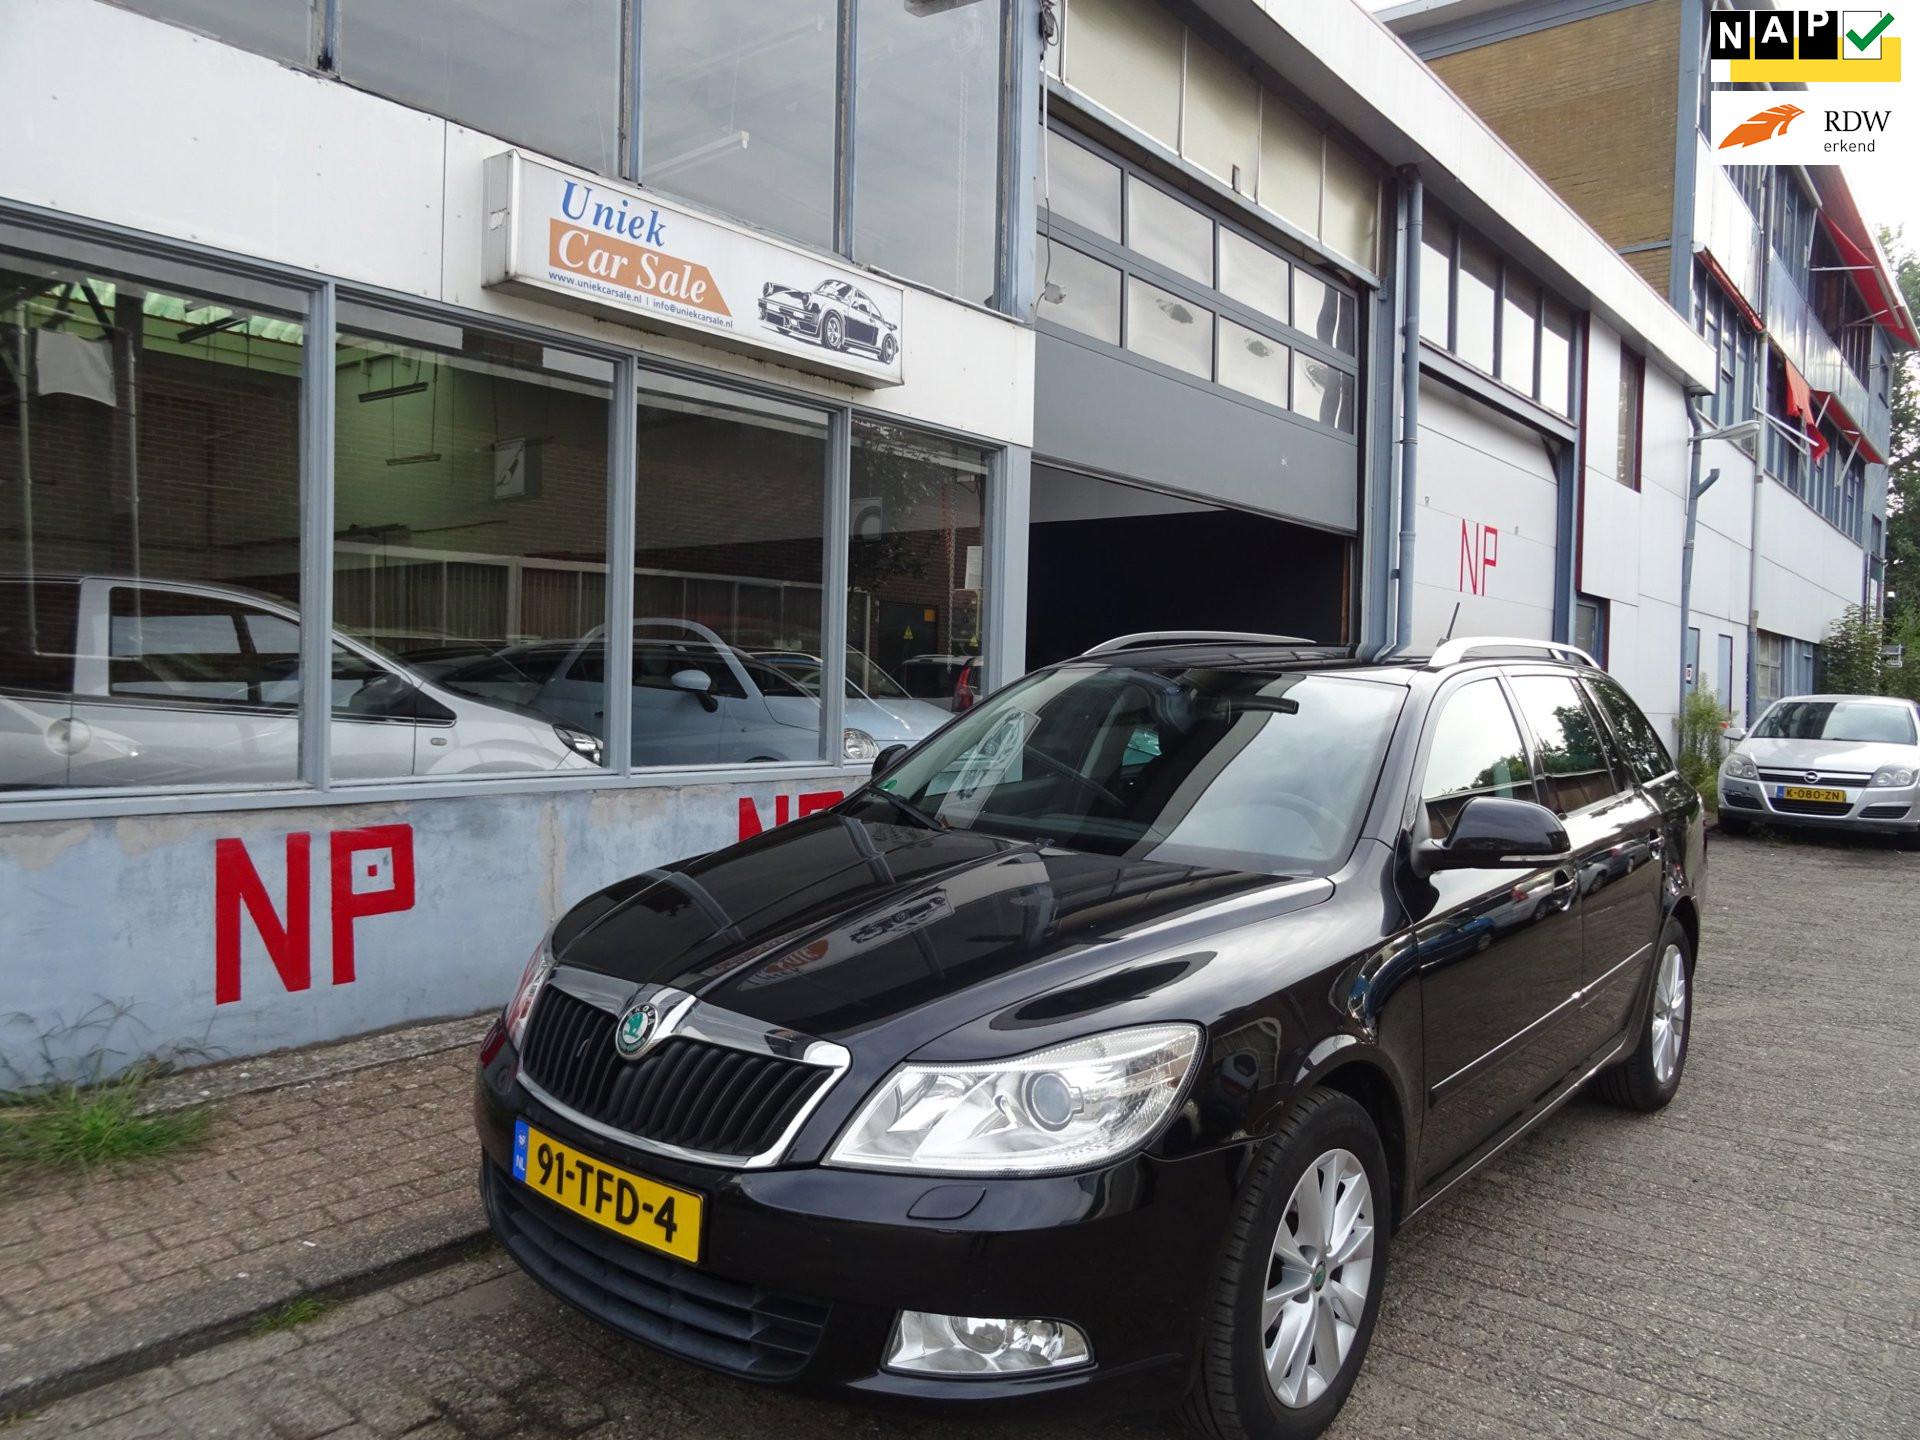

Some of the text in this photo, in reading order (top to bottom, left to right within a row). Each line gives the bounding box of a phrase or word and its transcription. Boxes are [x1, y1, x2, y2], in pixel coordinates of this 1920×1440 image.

[562, 179, 667, 248] Uniek
[548, 270, 733, 329] www.uniekcarsale.nl info@uniekcarsale.nl
[558, 229, 707, 303] Car Sale
[1459, 518, 1498, 597] NP
[1785, 788, 1840, 801] K-080-ZN
[215, 823, 416, 1005] NP
[537, 1143, 678, 1243] 91-TFD-4
